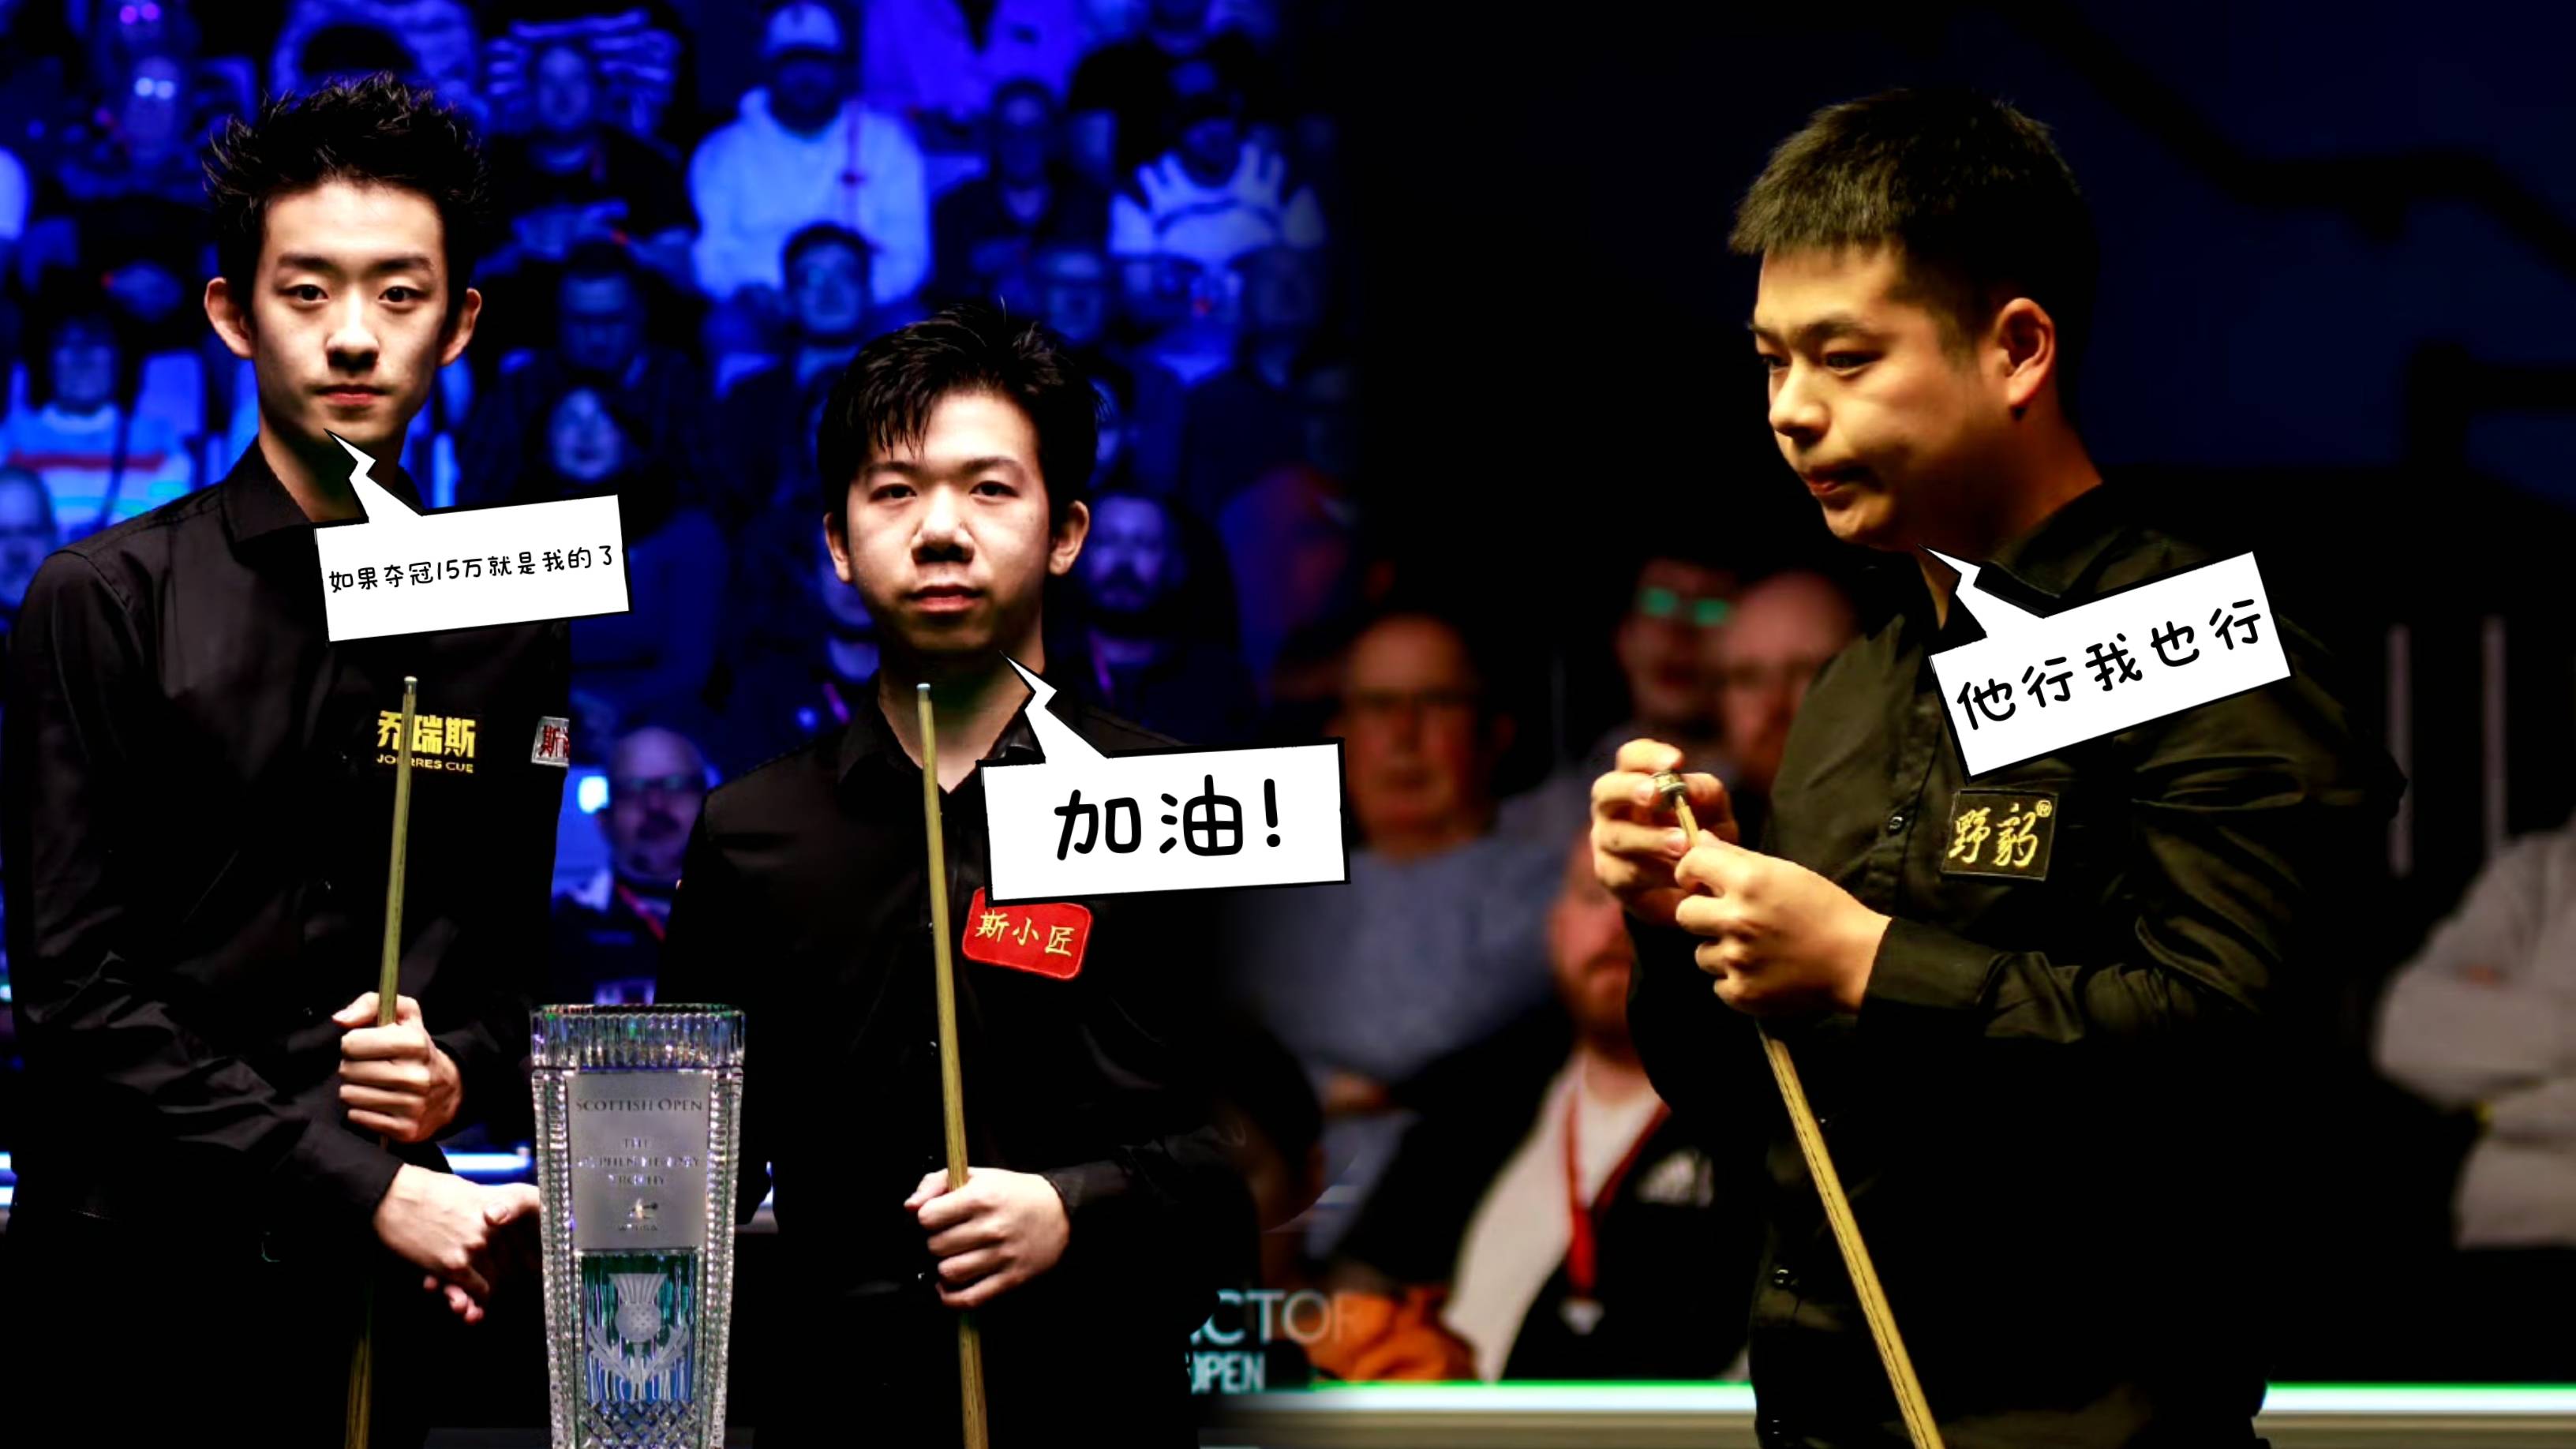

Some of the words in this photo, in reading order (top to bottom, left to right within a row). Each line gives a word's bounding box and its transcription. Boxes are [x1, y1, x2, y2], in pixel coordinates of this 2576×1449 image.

[377, 710, 476, 758] 乔瑞斯
[445, 762, 474, 773] CUE
[975, 908, 1075, 957] 斯小匠
[657, 1097, 702, 1111] OPEN
